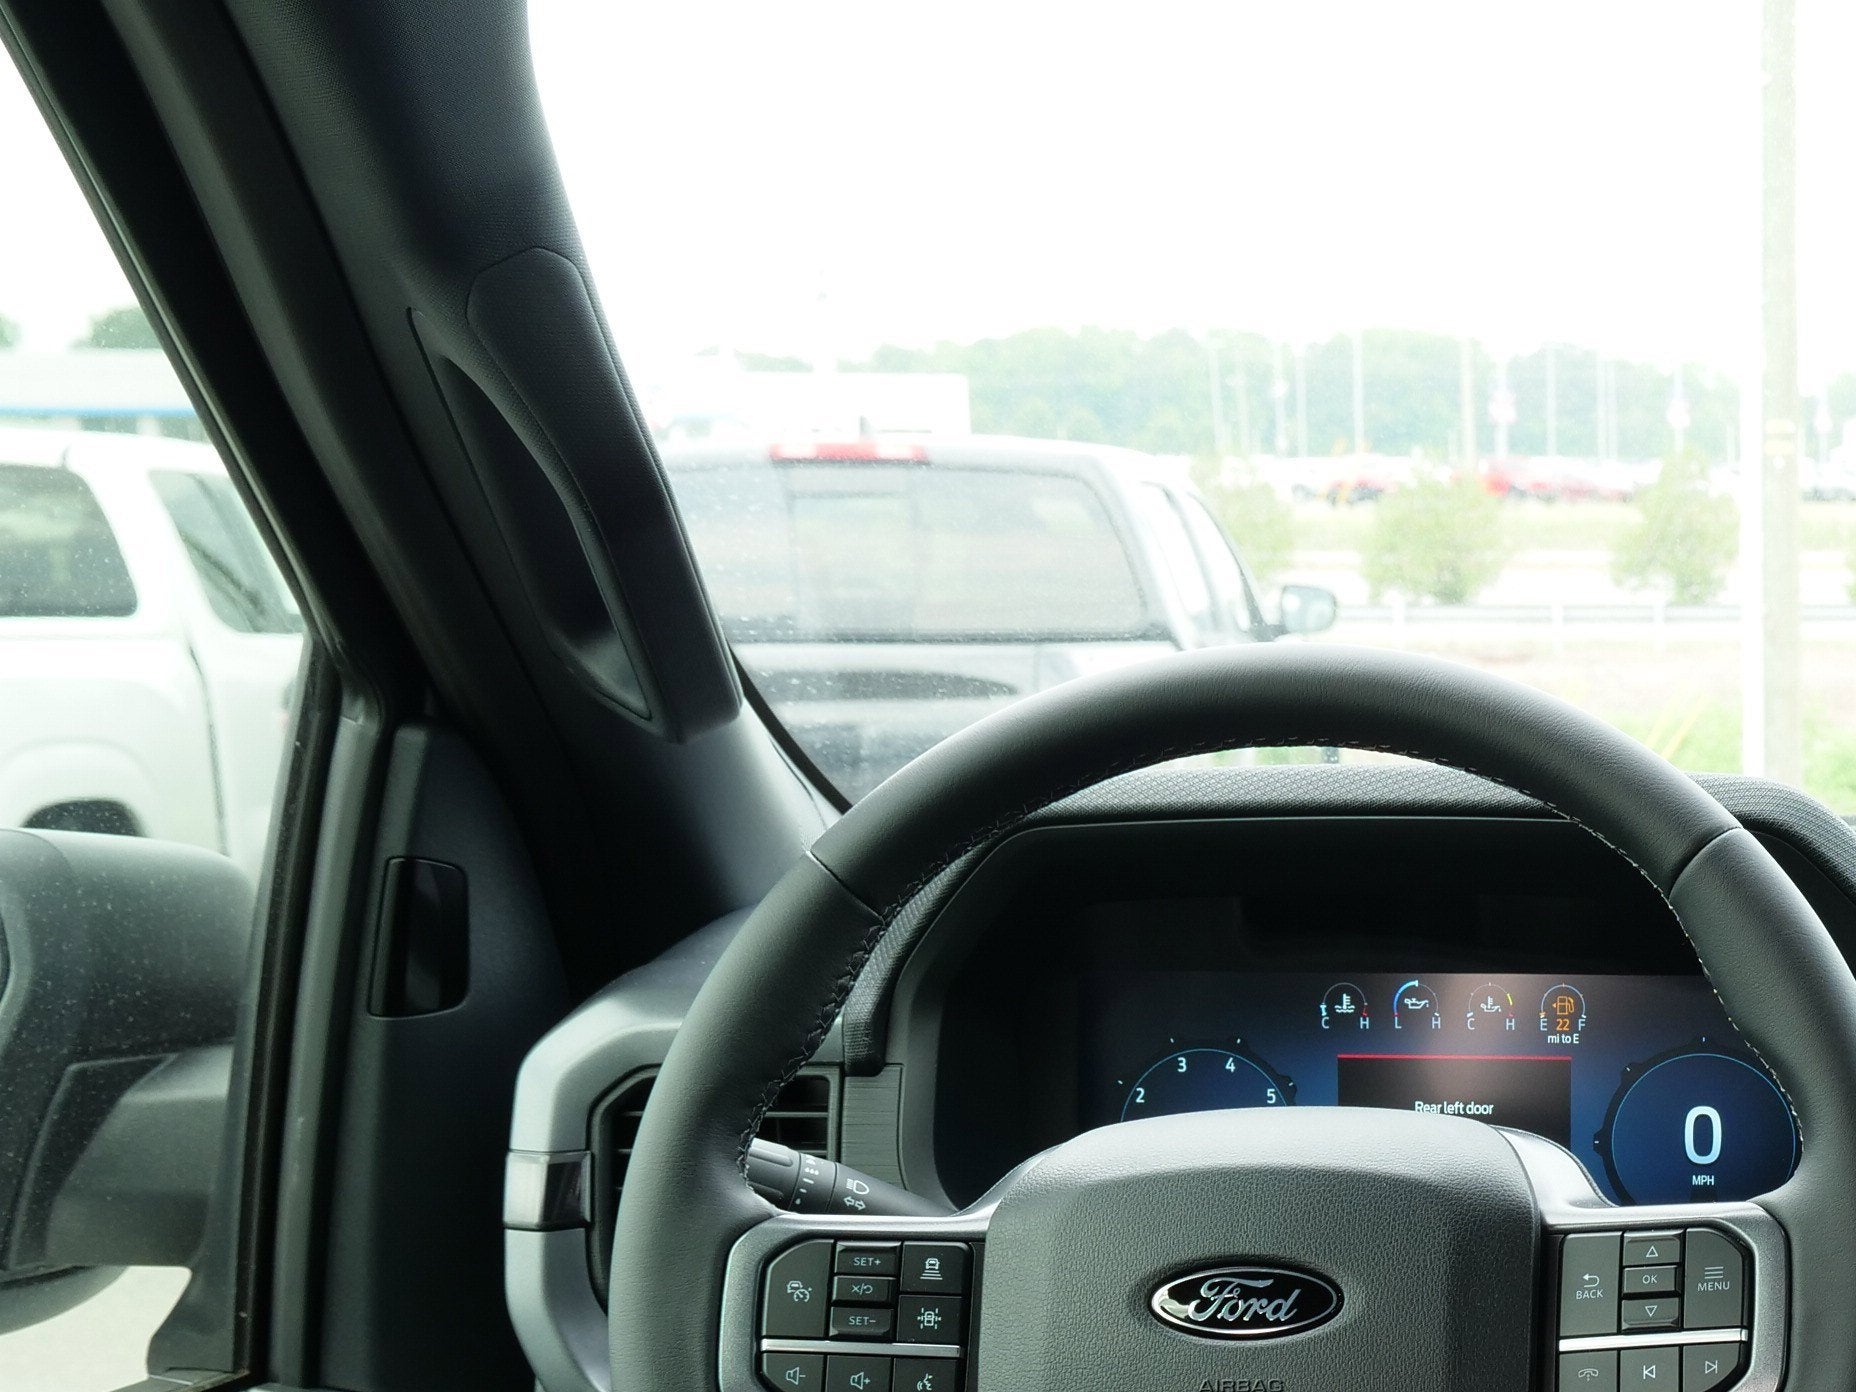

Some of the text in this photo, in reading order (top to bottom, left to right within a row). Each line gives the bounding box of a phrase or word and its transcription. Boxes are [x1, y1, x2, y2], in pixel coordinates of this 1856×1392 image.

[1321, 1016, 1330, 1029] C
[1360, 1017, 1369, 1029] H
[1394, 1017, 1402, 1029] L
[1432, 1017, 1441, 1029] H
[1467, 1018, 1475, 1030] C
[1506, 1018, 1515, 1030] H
[1540, 1019, 1548, 1031] E
[1556, 1018, 1570, 1031] 22
[1578, 1019, 1586, 1031] F
[1548, 1033, 1579, 1044] mi to E
[1177, 1057, 1188, 1073] 3
[1225, 1057, 1236, 1073] 4
[1135, 1087, 1146, 1104] 2
[1266, 1088, 1277, 1104] 5
[1415, 1101, 1494, 1115] Rear left door
[1684, 1106, 1722, 1165] 0
[1692, 1175, 1715, 1186] MPH
[853, 1257, 881, 1266] SET+
[1642, 1274, 1657, 1284] OK
[1697, 1281, 1730, 1292] MENU
[1188, 1276, 1302, 1321] Ford
[1576, 1289, 1603, 1300] BACK
